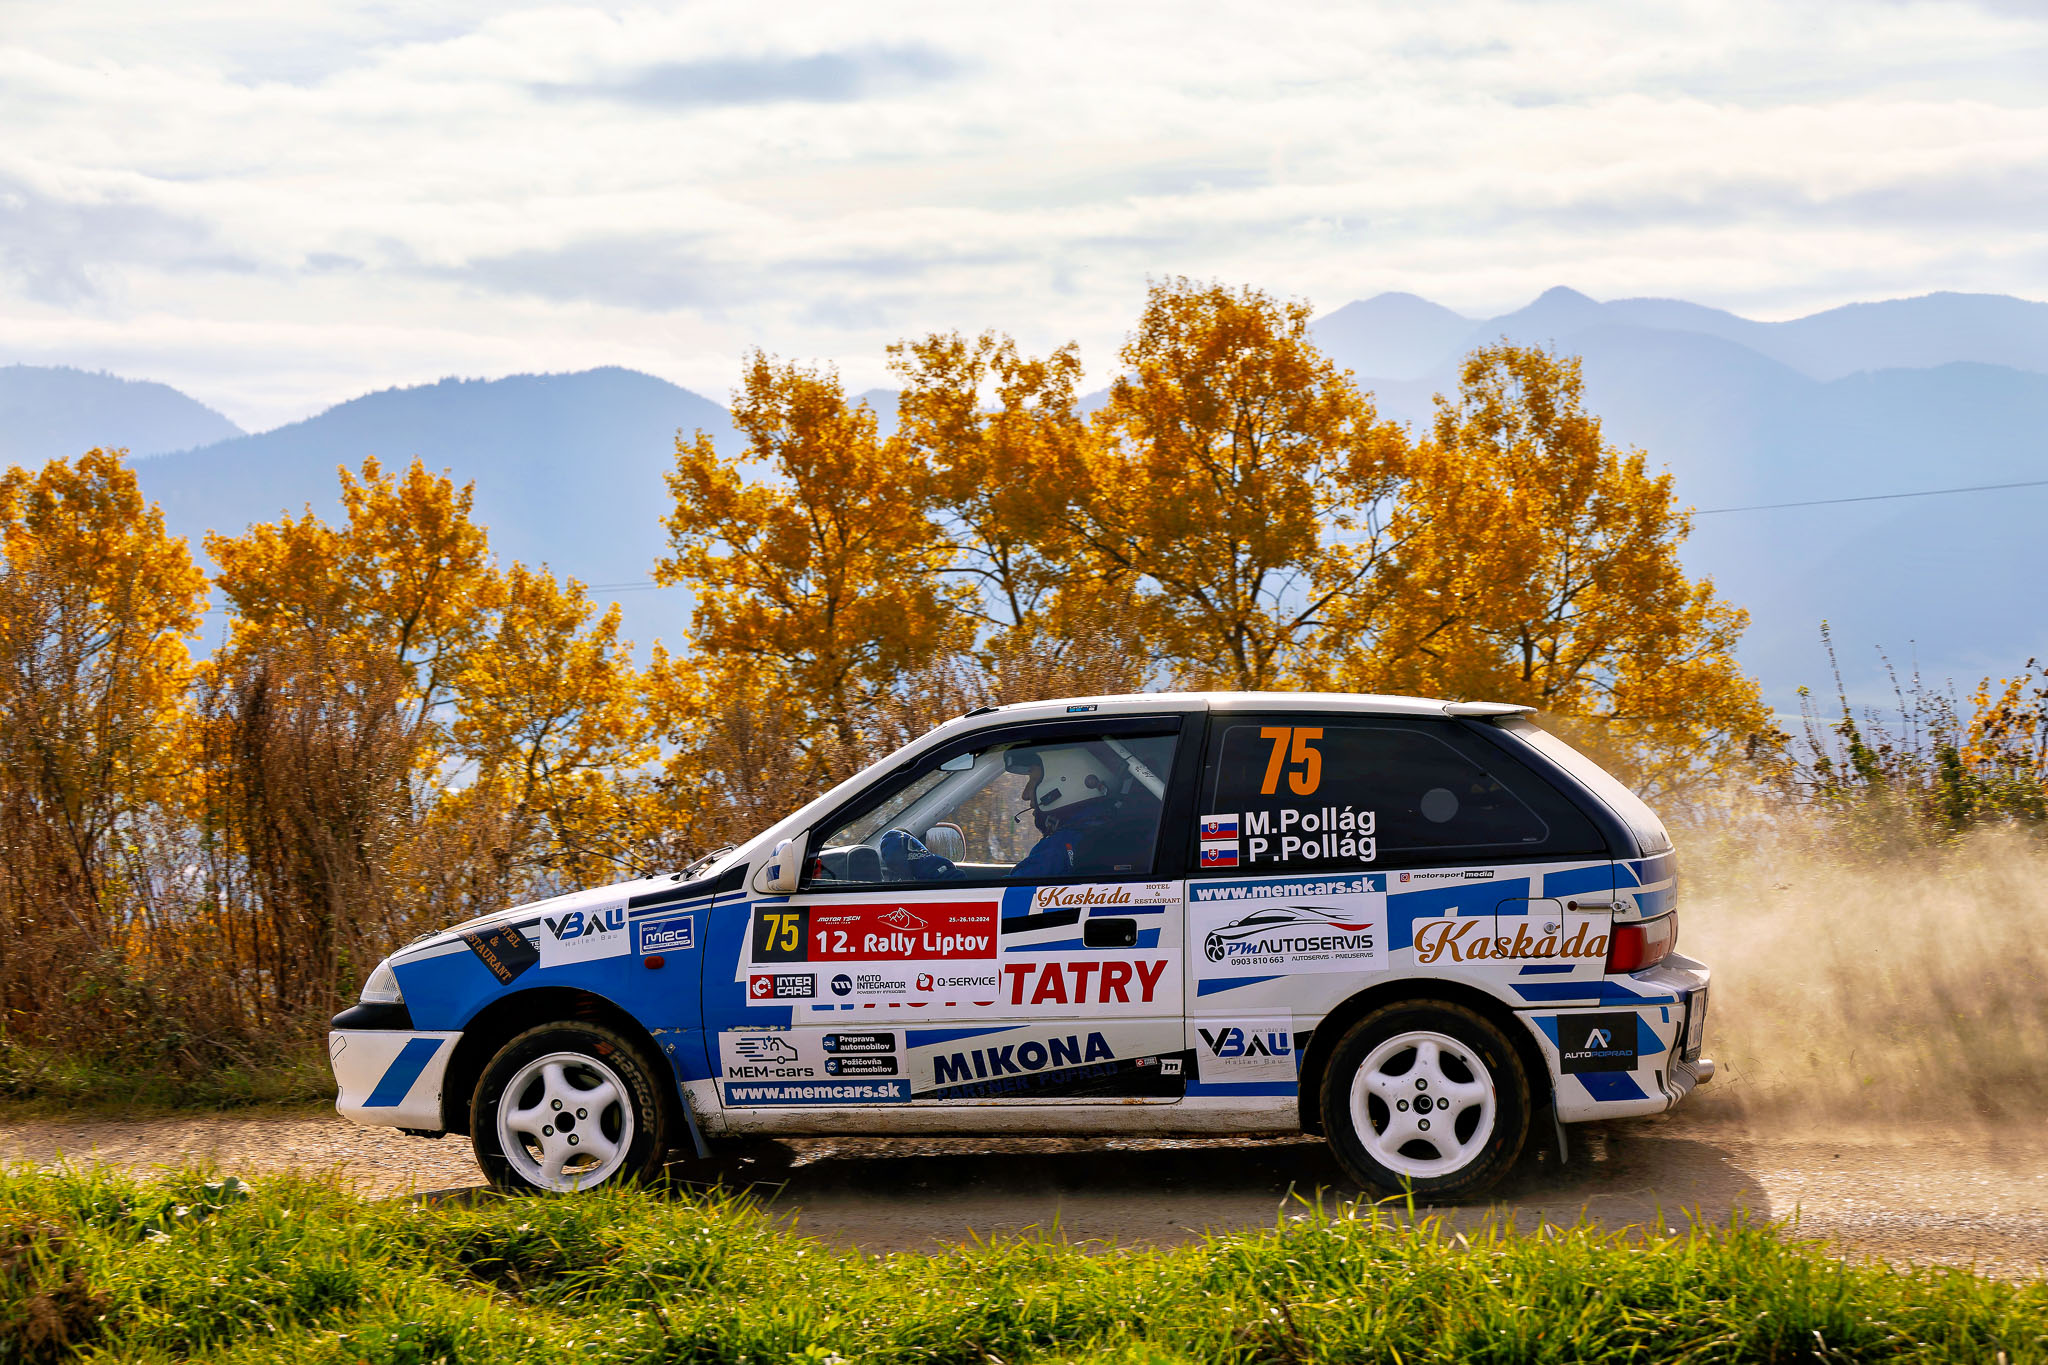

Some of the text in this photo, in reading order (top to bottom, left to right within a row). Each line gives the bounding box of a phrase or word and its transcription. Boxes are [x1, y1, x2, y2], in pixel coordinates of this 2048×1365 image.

[1260, 726, 1324, 795] 75
[1245, 806, 1376, 835] M.Pollág
[1249, 832, 1376, 862] P.Pollág
[1037, 886, 1131, 908] Kaskáda
[1196, 876, 1376, 901] www.memcars.sk
[543, 907, 626, 941] VBAU
[763, 913, 800, 952] 75
[489, 935, 500, 947] &
[497, 923, 521, 949] OTEL
[815, 930, 989, 957] 12. Rally Liptov
[1413, 920, 1609, 963] Kaskáda
[1231, 956, 1285, 966] 0903 810 663
[1291, 954, 1330, 962] AUTOSERVIS
[1335, 952, 1374, 960] PNEUSERVIS
[776, 976, 812, 986] INTER
[776, 986, 812, 996] CARS
[856, 981, 906, 990] INTEGRATOR
[839, 1035, 876, 1044] Preprava
[840, 1042, 890, 1051] automobilov
[1197, 1027, 1292, 1057] VBAU
[841, 1058, 882, 1067] Požičovňa
[932, 1031, 1116, 1085] MIKONA
[728, 1066, 815, 1079] MEM-cars
[842, 1065, 893, 1074] automobilov
[731, 1082, 901, 1100] www.memcars.sk
[937, 1062, 1119, 1101] PARTNER POPRAD
